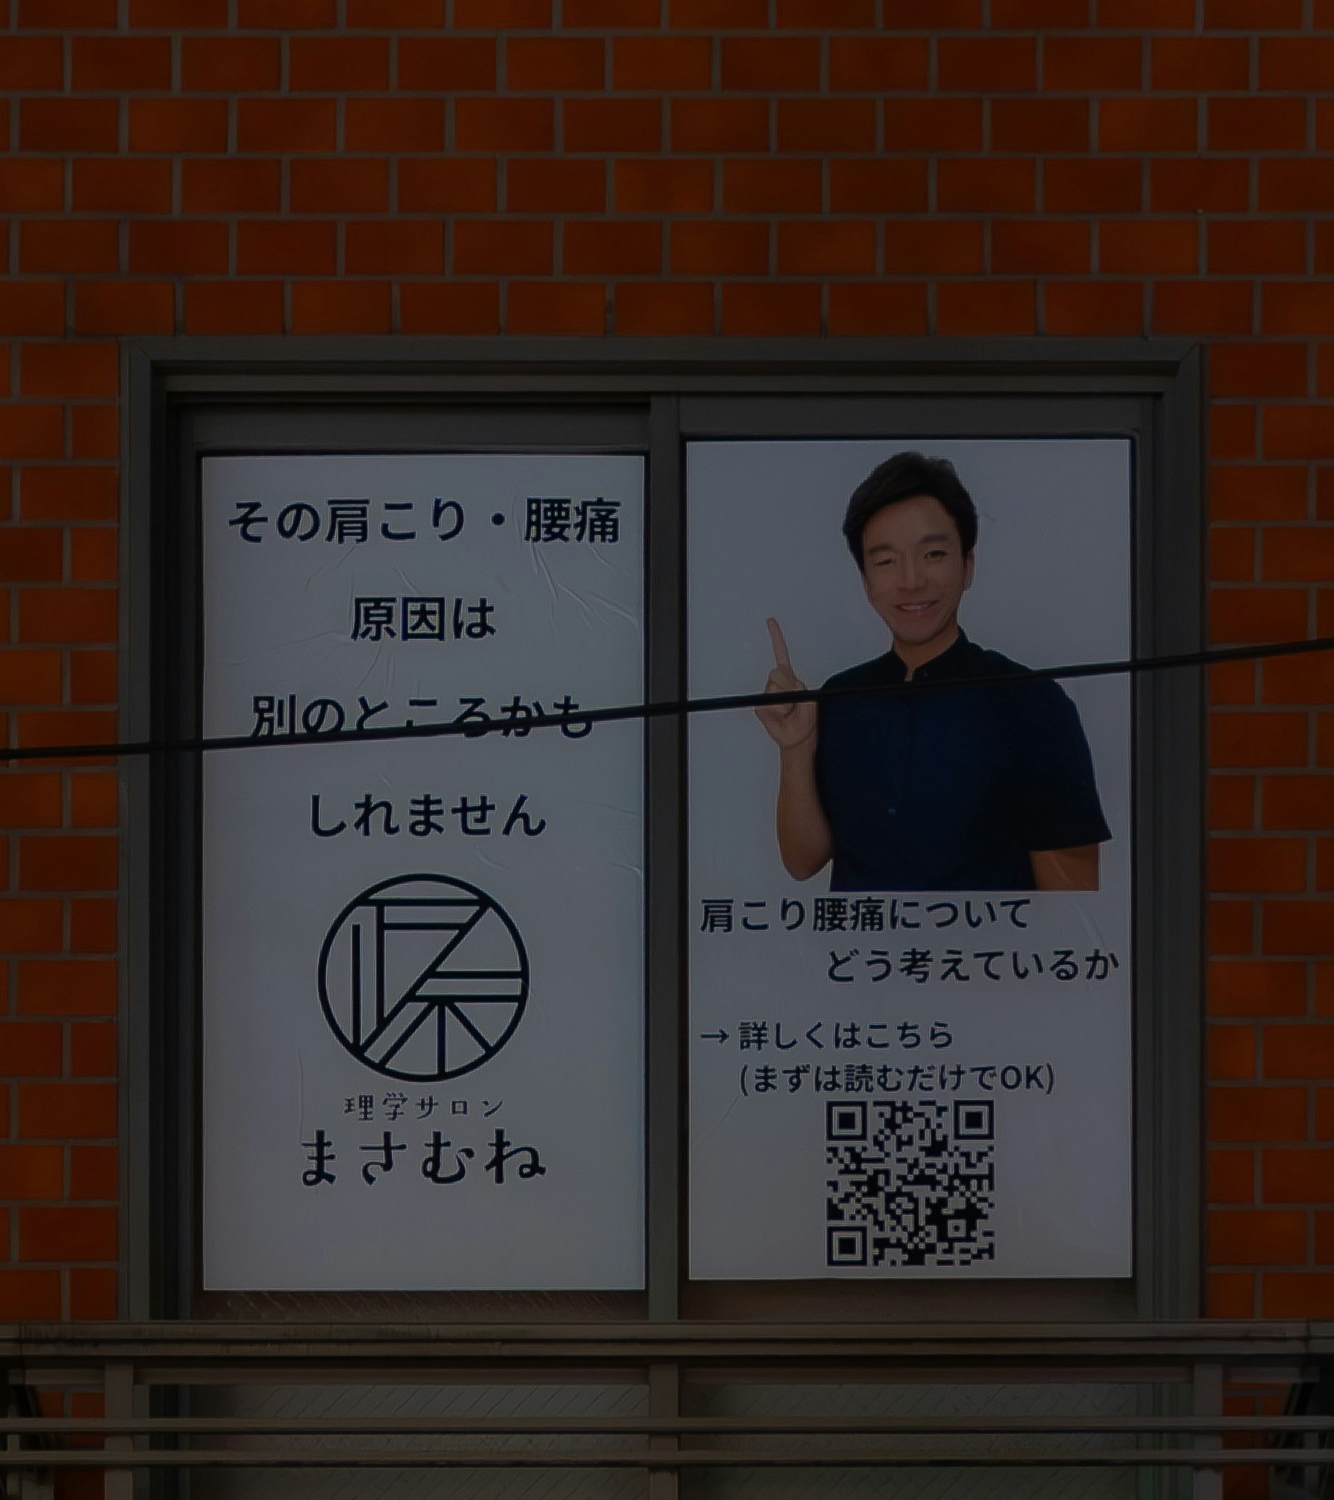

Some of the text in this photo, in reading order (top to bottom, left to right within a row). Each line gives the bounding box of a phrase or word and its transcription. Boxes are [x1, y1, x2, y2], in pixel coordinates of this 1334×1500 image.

[227, 496, 621, 546] その肩こり・腰痛
[349, 594, 497, 643] 原因は
[251, 692, 595, 742] 別のところかも
[307, 792, 547, 839] しれません
[699, 895, 1030, 933] 肩こり腰痛について
[823, 947, 1120, 983] どう考えているか
[738, 1020, 954, 1052] 詳しくはこちら
[739, 1061, 1055, 1096] (まずは読むだけでOK)
[342, 1092, 505, 1122] 理学サロン
[300, 1127, 547, 1188] まさむね
